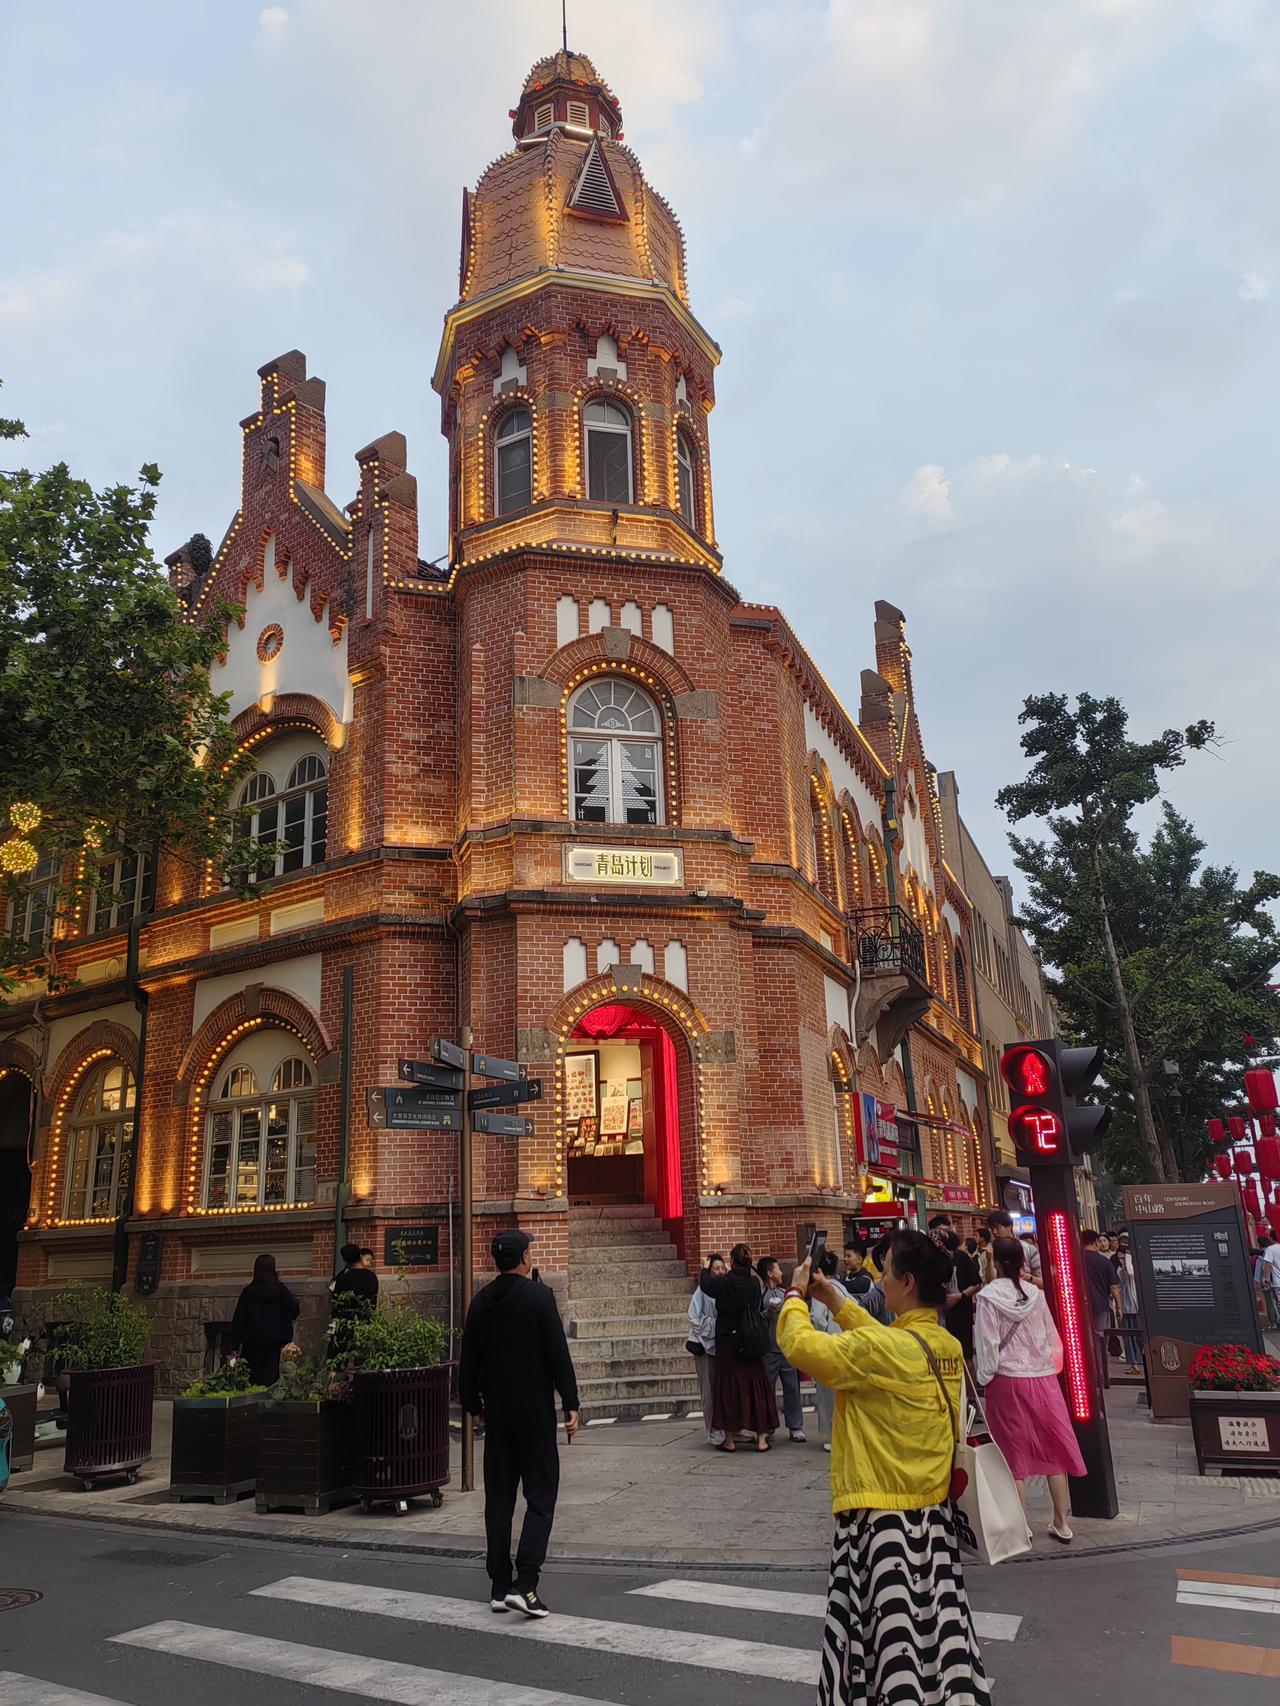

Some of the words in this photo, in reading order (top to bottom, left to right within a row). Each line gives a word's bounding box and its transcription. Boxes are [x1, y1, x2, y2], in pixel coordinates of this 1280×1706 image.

[596, 853, 653, 877] 青岛计划
[1024, 1115, 1057, 1149] 72
[1134, 1193, 1153, 1204] 百年
[1135, 1203, 1165, 1214] 中山路
